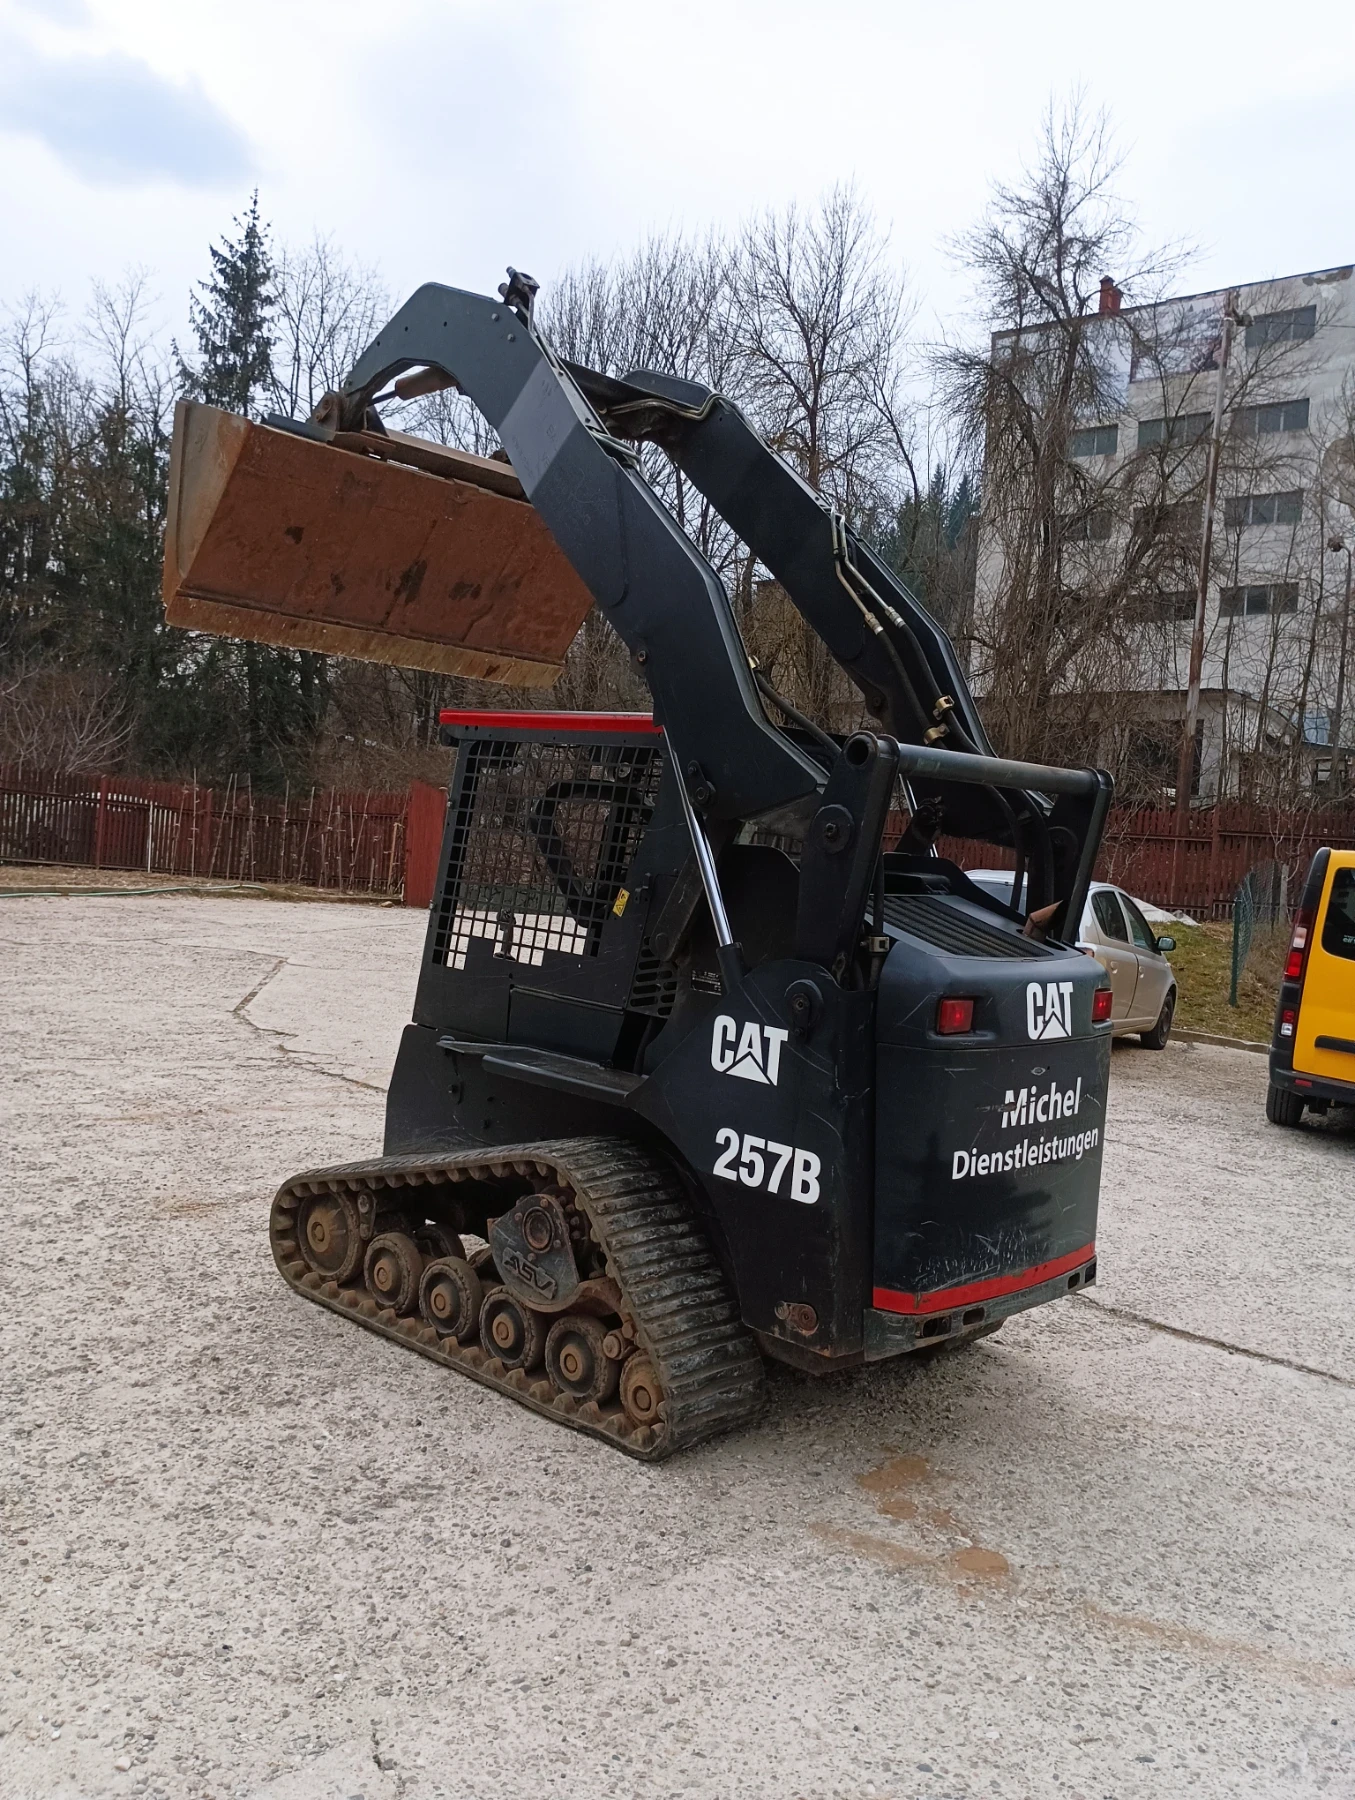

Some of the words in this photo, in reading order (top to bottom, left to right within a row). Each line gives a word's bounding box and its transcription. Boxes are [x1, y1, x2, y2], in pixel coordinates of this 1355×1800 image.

[1026, 981, 1074, 1040] CAT
[710, 1014, 789, 1086] CAT
[1001, 1077, 1082, 1129] Michel
[712, 1127, 821, 1204] 257B
[951, 1127, 1099, 1180] Dienstleistungen
